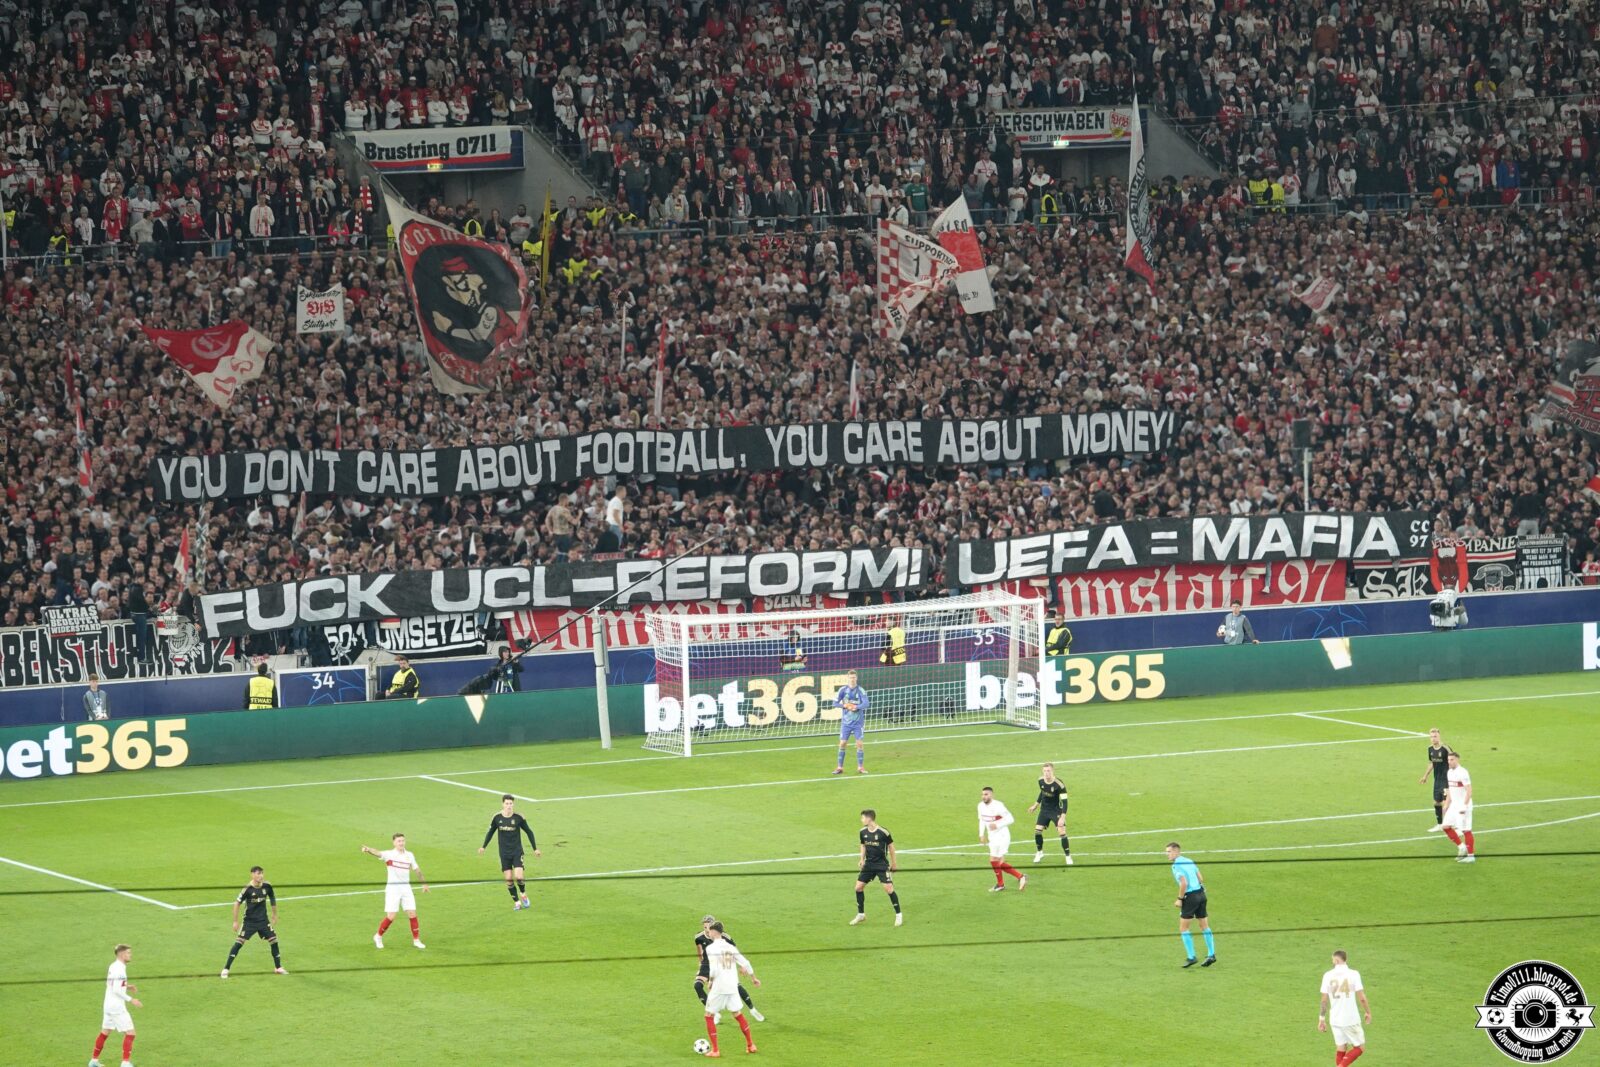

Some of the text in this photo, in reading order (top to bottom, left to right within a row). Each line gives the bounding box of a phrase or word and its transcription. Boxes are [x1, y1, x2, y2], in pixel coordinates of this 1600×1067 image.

[363, 133, 496, 161] Brustring 0711
[157, 410, 1175, 500] YOU DON'T CARE ABOUT FOOTBALL, YOU CARE ABOUT MONEY!
[958, 525, 1138, 585] UEFA
[1192, 514, 1400, 561] MAFIA
[1409, 534, 1429, 547] 97
[48, 605, 98, 620] ULTRAS
[200, 573, 397, 639] FUCK
[49, 616, 99, 628] BEDEUTET
[51, 623, 101, 634] WIDERSTAND
[974, 629, 995, 646] 35
[312, 673, 335, 690] 34
[965, 653, 1166, 711] bet365
[644, 674, 849, 733] bet365
[0, 718, 189, 778] et365
[1329, 978, 1350, 999] 24
